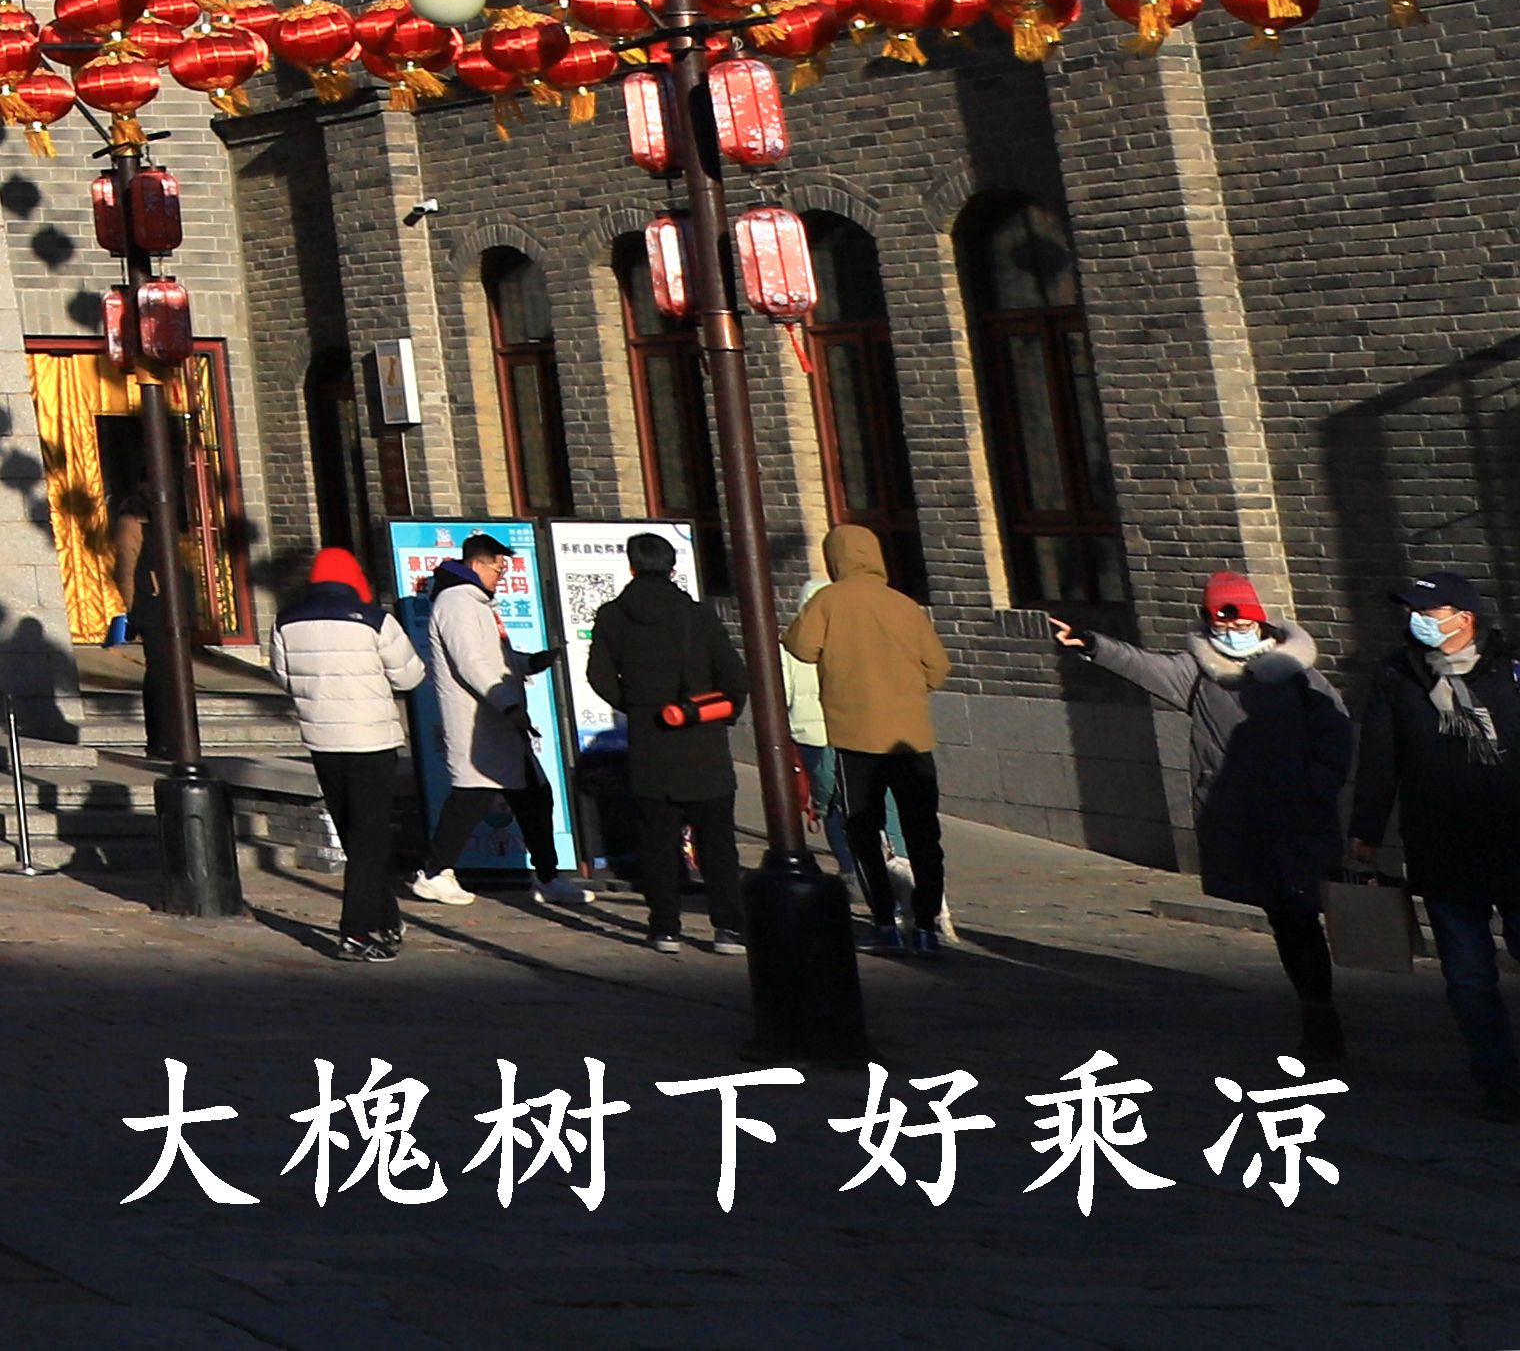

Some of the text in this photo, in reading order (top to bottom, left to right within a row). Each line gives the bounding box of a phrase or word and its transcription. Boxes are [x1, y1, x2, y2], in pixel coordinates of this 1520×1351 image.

[560, 543, 627, 555] 手机自助购票
